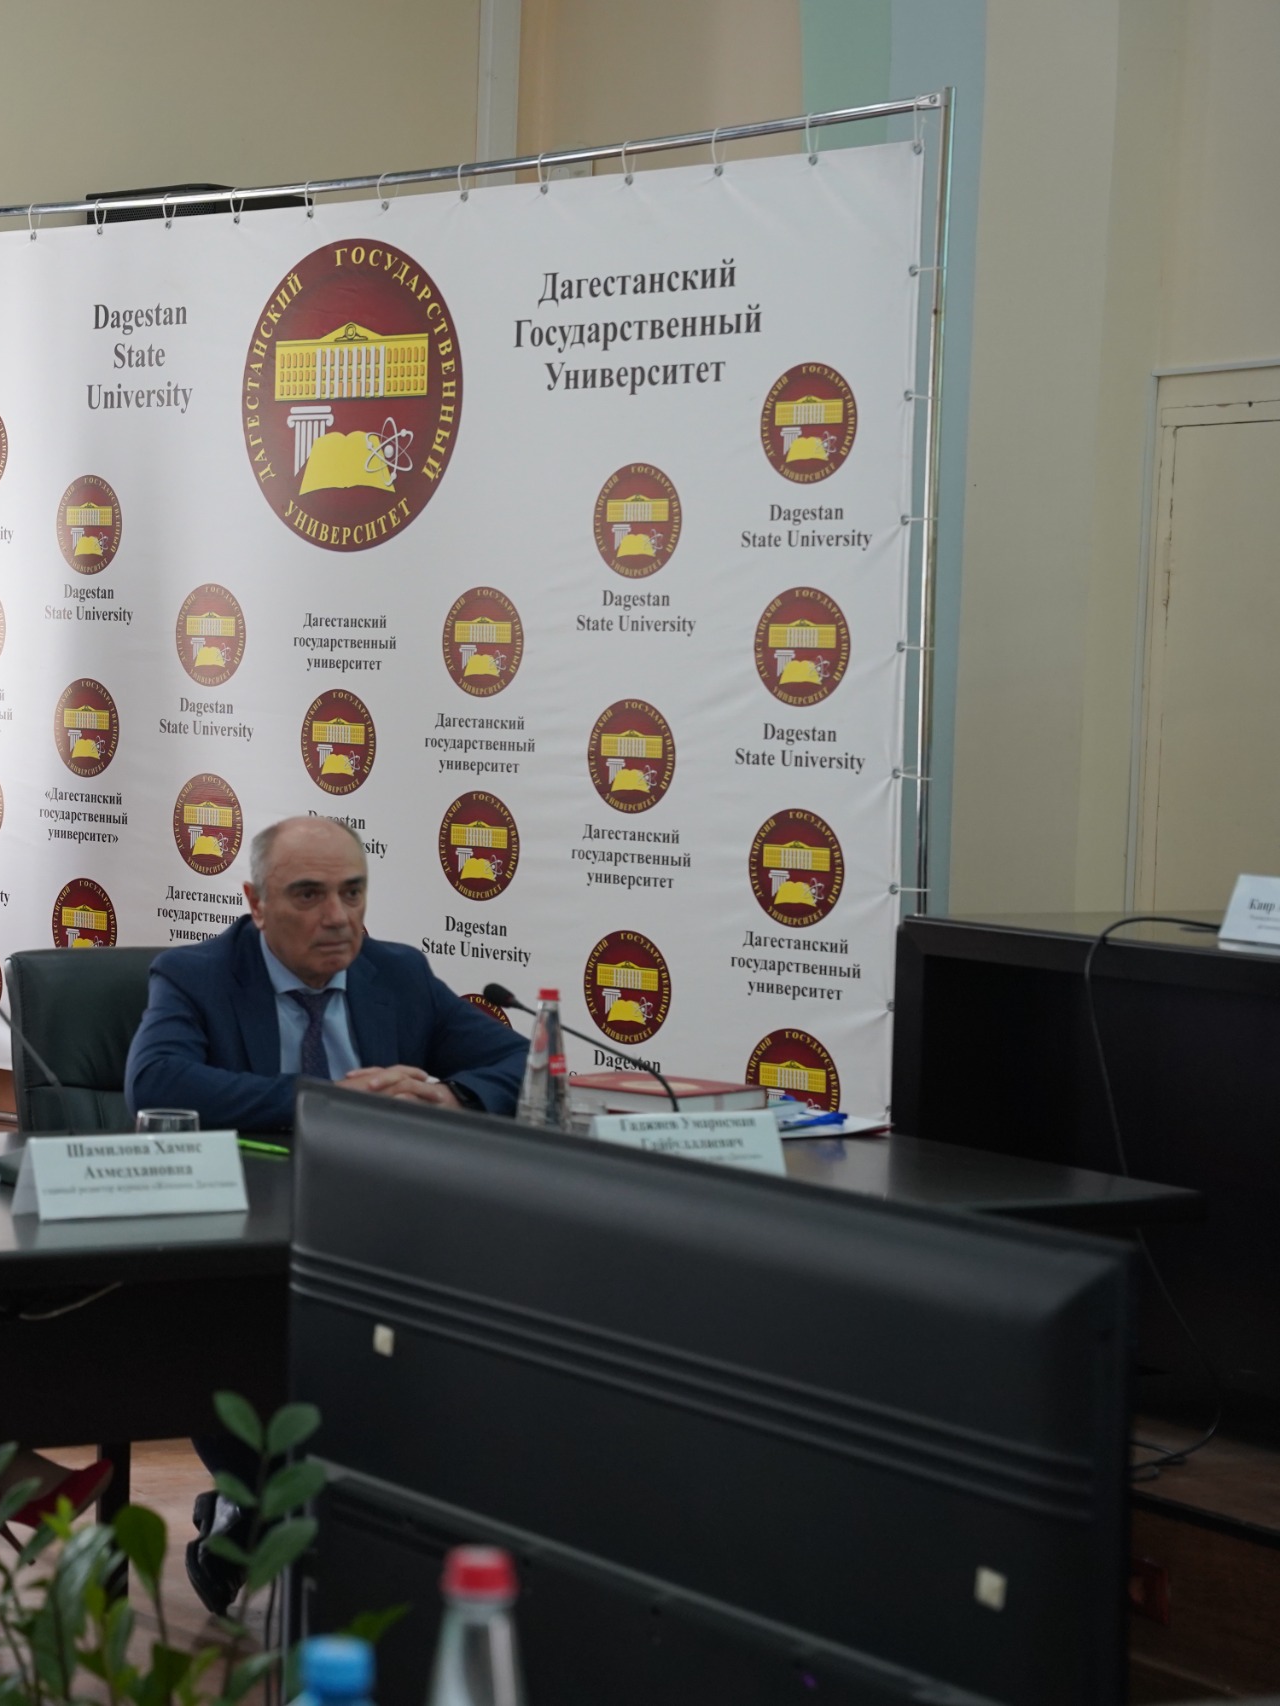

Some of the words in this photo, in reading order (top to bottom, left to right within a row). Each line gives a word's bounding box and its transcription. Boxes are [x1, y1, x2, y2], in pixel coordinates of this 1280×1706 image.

[538, 258, 736, 307] Дагестанский
[93, 304, 187, 335] Dagestan
[514, 304, 761, 354] Государственный
[114, 343, 165, 369] State
[334, 246, 456, 483] ГОСУДАРСТВЕННЫЙ
[246, 273, 303, 483] ДАГЕСТАНСКИЙ
[545, 361, 726, 395] Университет
[87, 381, 193, 414] University
[284, 497, 411, 545] УНИВЕРСИТЕТ
[770, 504, 843, 526] Dagestan
[741, 531, 782, 548] State
[788, 529, 872, 551] University
[64, 584, 114, 602] Dagestan
[603, 590, 670, 611] Dagestan
[45, 605, 73, 620] State
[76, 606, 133, 626] University
[303, 613, 386, 628] Дагестанский
[577, 615, 613, 631] State
[619, 615, 696, 637] University
[294, 636, 396, 652] государственный
[307, 658, 382, 673] университет
[180, 697, 233, 717] Dagestan
[159, 718, 189, 734] State
[193, 720, 254, 742] University
[434, 713, 524, 730] Дагестанский
[763, 723, 836, 745] Dagestan
[425, 738, 535, 753] государственный
[439, 760, 519, 775] университет
[735, 748, 775, 766] State
[781, 750, 865, 775] University
[45, 787, 122, 805] «Дагестанский
[40, 809, 128, 825] государственный
[48, 829, 119, 844] университет»
[582, 824, 679, 844] Дагестанский
[571, 849, 691, 867] государственный
[587, 872, 674, 890] университет
[165, 886, 243, 906] Дагестанский
[157, 907, 238, 924] государственн
[445, 916, 507, 938] Dagestan
[422, 937, 456, 956] State
[460, 941, 531, 967] University
[742, 931, 848, 954] Дагестанский
[731, 956, 861, 979] государственный
[747, 981, 842, 1000] университет
